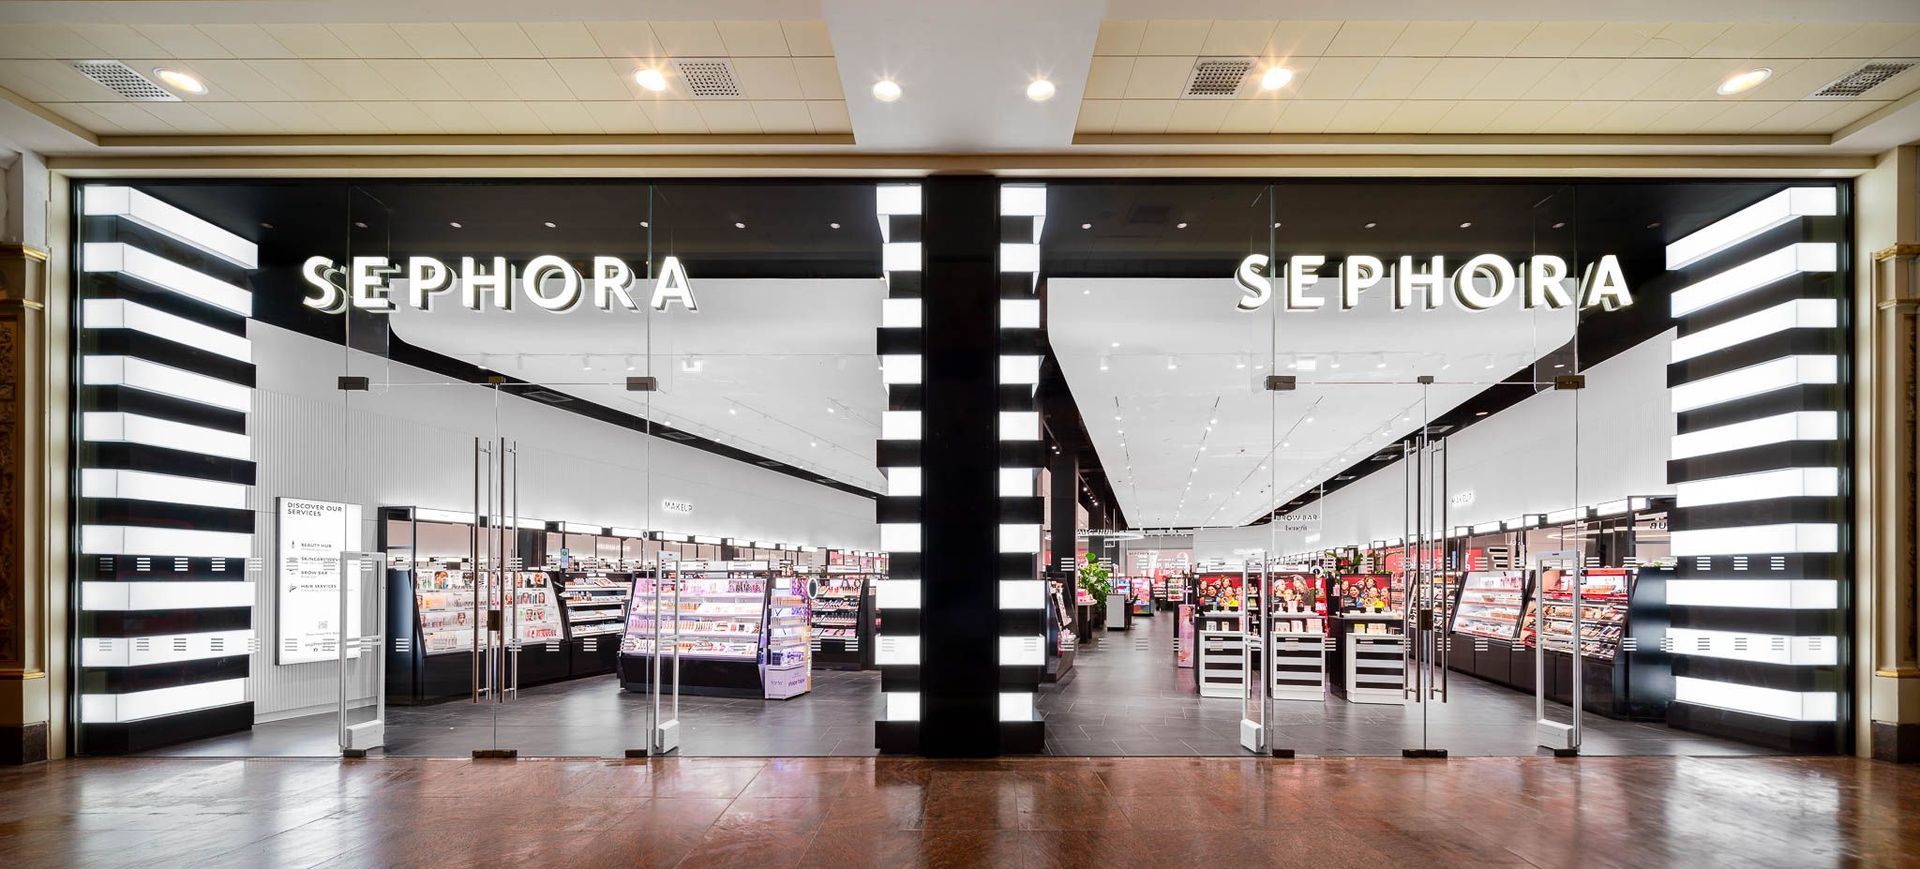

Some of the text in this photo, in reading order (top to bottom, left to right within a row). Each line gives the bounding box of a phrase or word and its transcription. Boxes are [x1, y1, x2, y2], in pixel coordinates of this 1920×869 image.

[302, 254, 698, 312] SEPHORA
[1235, 253, 1633, 312] SEPHORA
[287, 502, 325, 511] DISCOVER
[664, 501, 693, 512] MAKEUP
[287, 508, 322, 517] SERVICES
